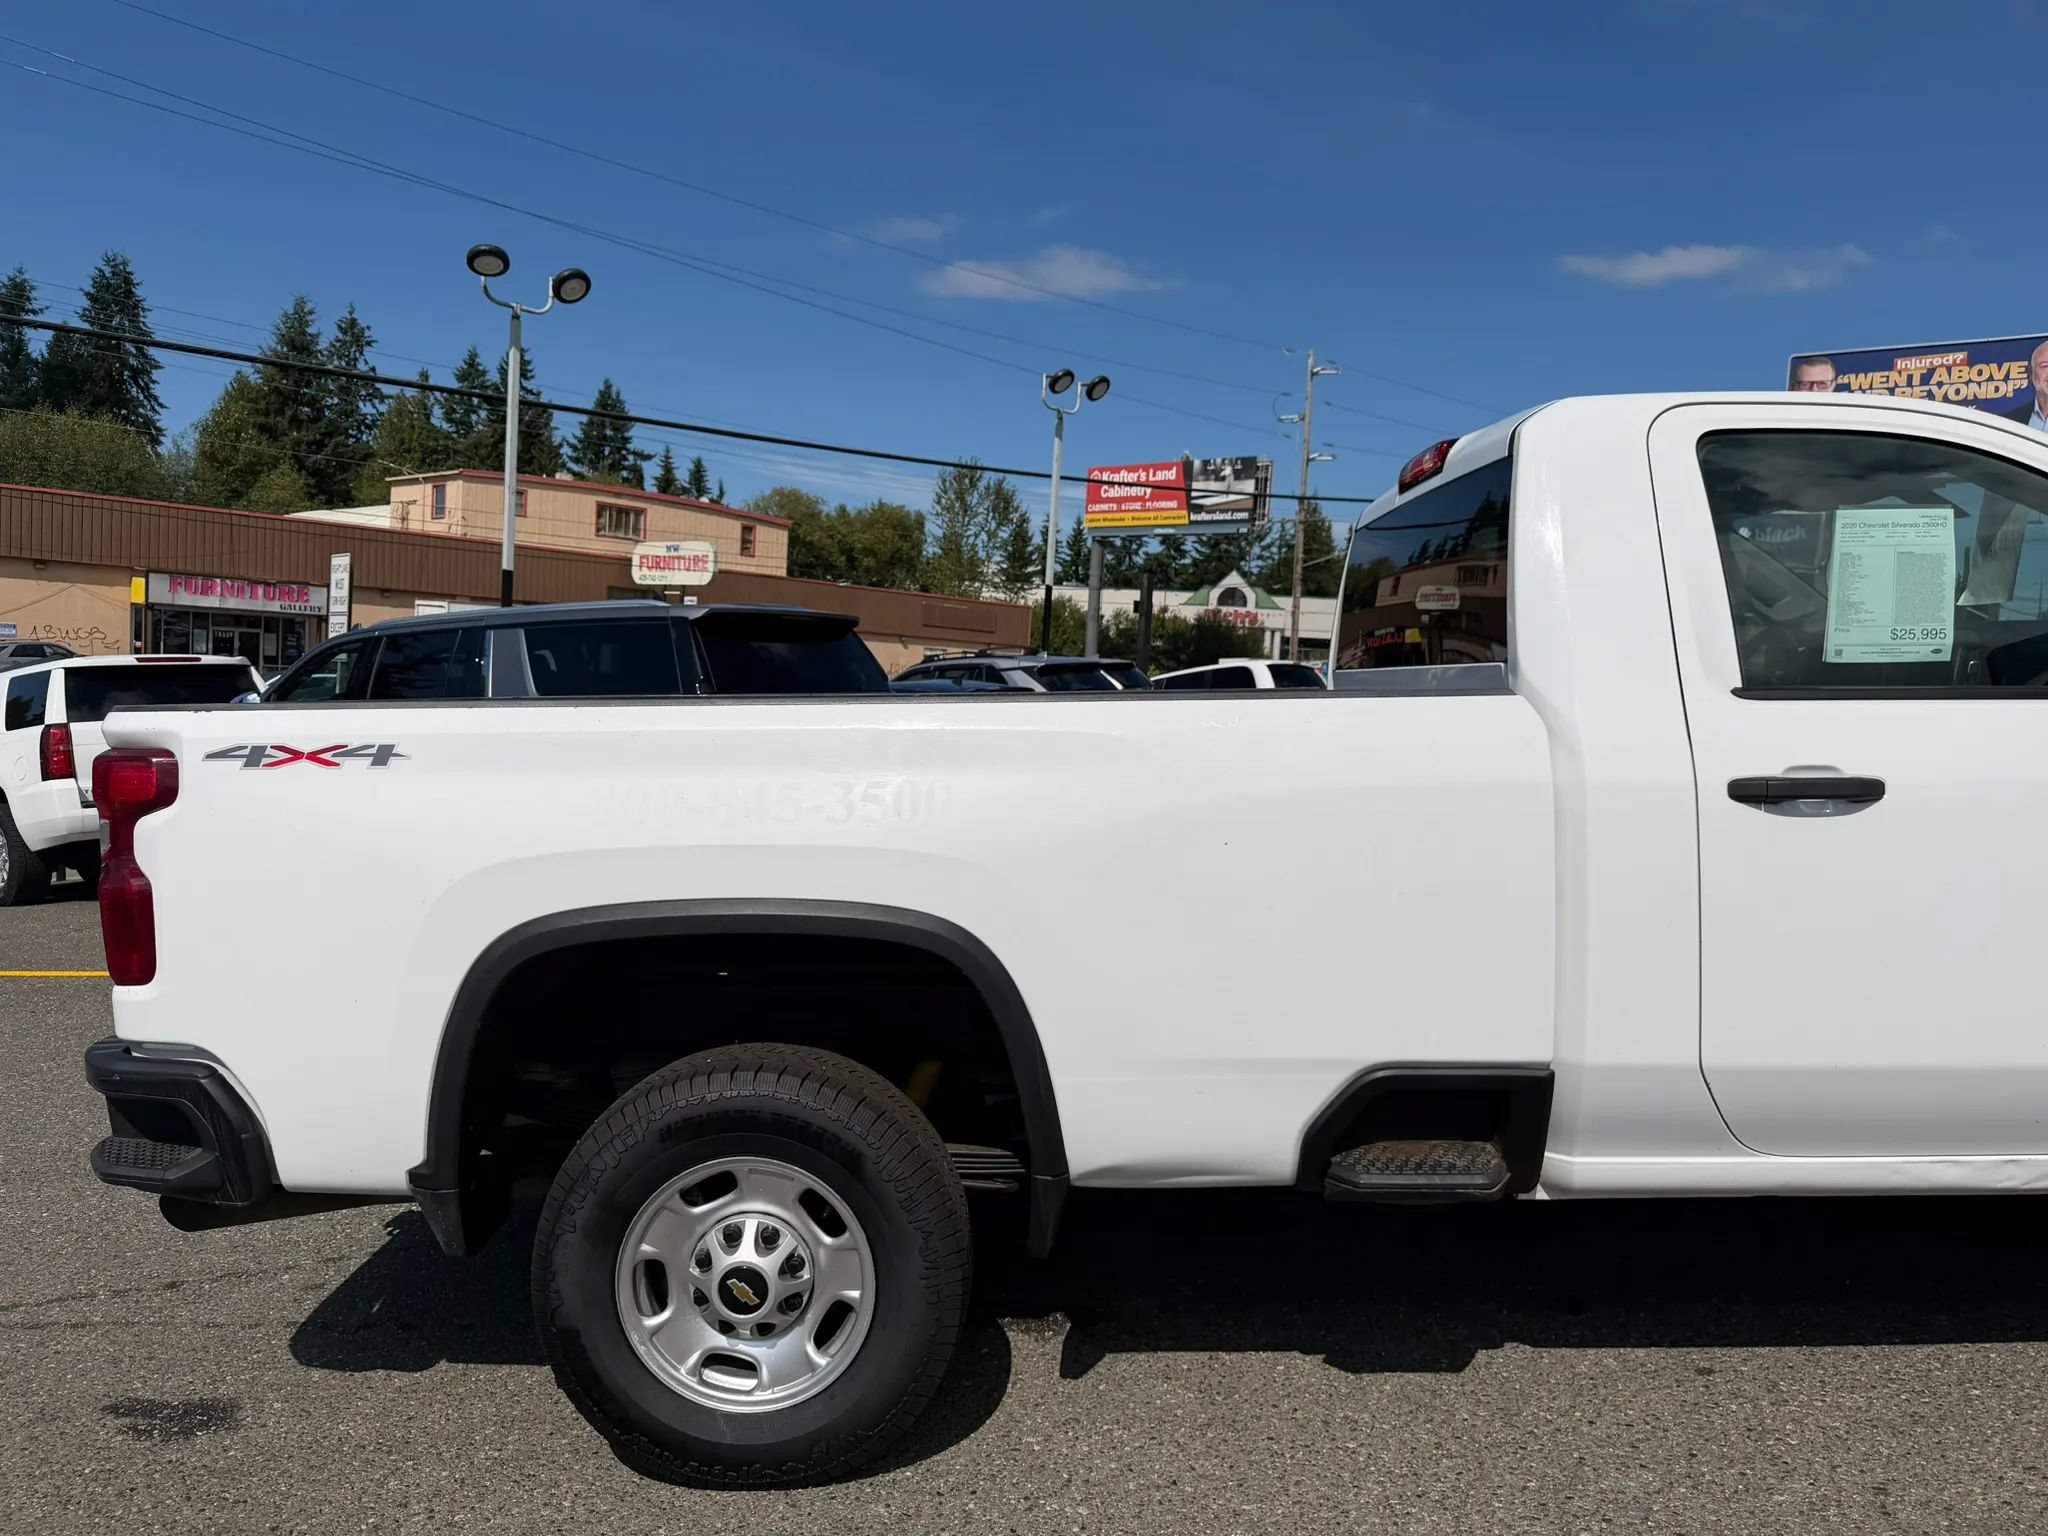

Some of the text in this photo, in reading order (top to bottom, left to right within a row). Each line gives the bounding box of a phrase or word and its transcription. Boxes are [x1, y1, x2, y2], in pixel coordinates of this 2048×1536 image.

[1896, 353, 1965, 370] Injured?
[1930, 361, 2029, 387] ABOVE
[1102, 465, 1177, 483] Krafter's Land
[1101, 485, 1153, 499] Cabinetry
[1087, 503, 1117, 512] CABINETS
[1146, 500, 1178, 510] FLOORING
[1190, 510, 1249, 521] kraftersland.com
[1841, 522, 1858, 530] 2020
[1859, 521, 1890, 529] Chevrolet
[1891, 521, 1921, 529] Silverado
[665, 543, 680, 553] NW
[639, 554, 710, 572] FURNITURE
[168, 575, 312, 603] FURNITURE
[279, 602, 323, 613] GALLERY
[1889, 627, 1948, 642] $25,995
